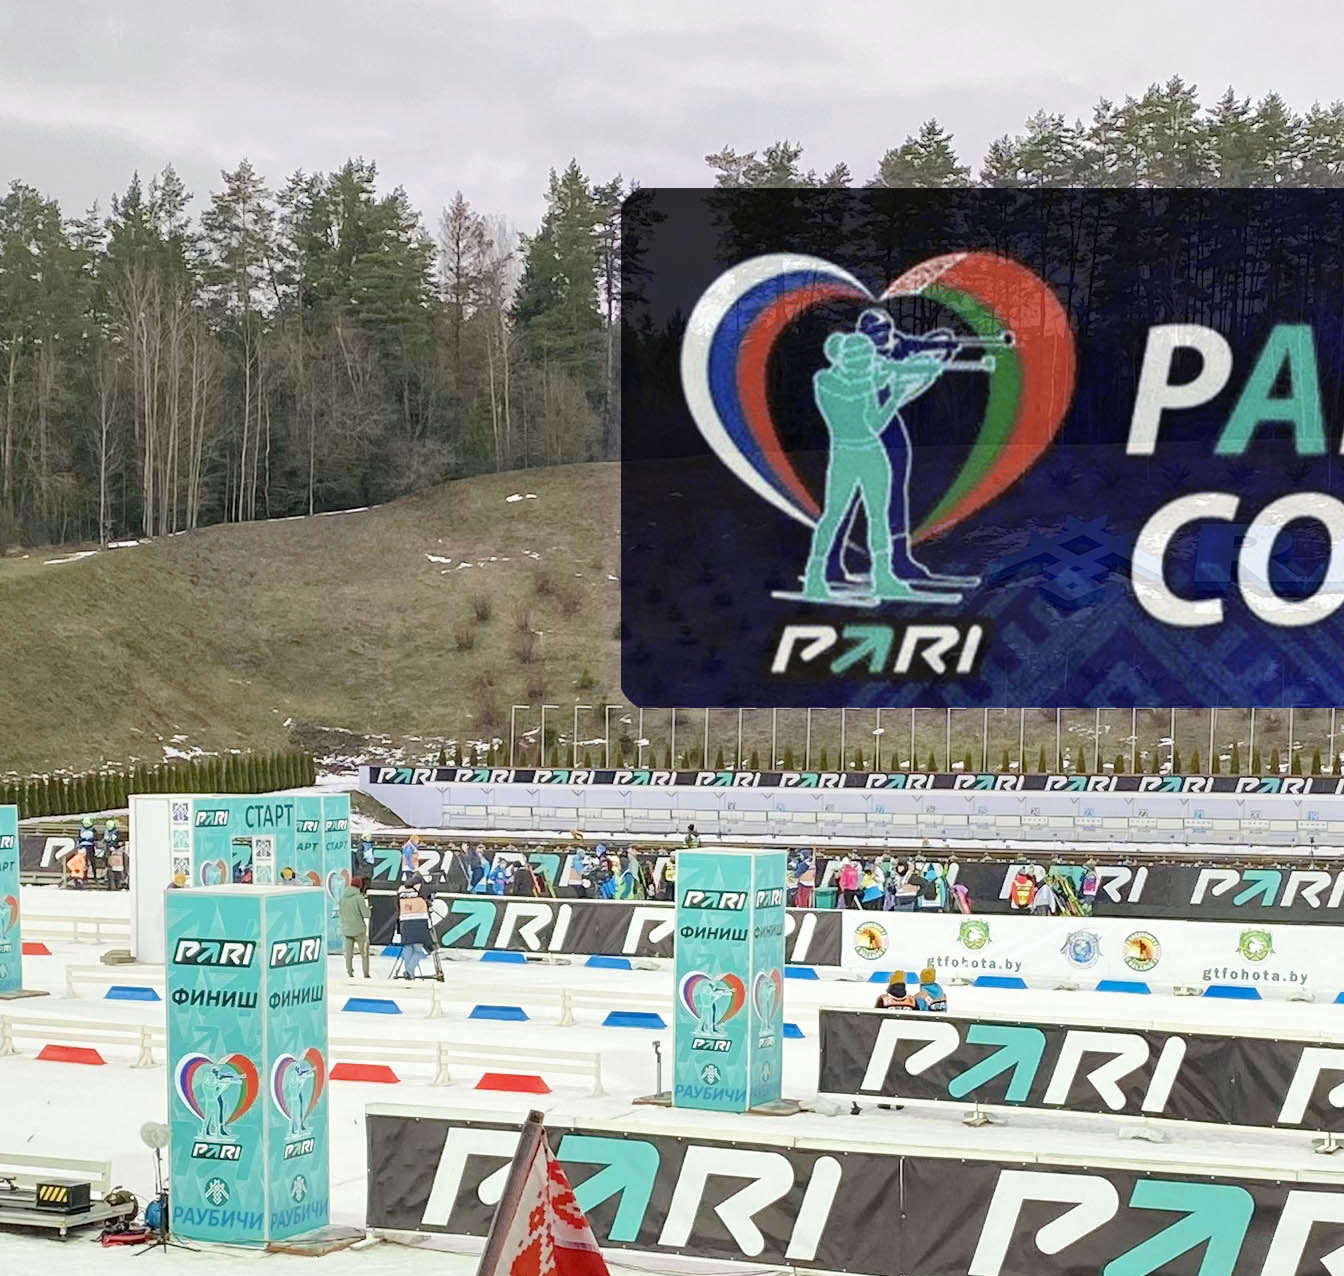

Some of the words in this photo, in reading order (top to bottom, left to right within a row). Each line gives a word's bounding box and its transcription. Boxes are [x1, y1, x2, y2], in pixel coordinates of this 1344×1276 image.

[378, 767, 437, 785] PARI
[455, 768, 515, 784] PARI
[533, 769, 595, 785] PARI
[613, 770, 676, 786] PARI
[696, 771, 761, 787] PARI
[780, 773, 847, 788] PARI
[864, 774, 934, 790] PARI
[954, 775, 1025, 790] PARI
[1044, 776, 1118, 791] PARI
[1138, 776, 1213, 792] PARI
[1234, 777, 1313, 793] PARI
[196, 810, 229, 826] PARI
[245, 804, 293, 828] СТАРТ
[326, 841, 348, 851] СТАРТ
[684, 890, 747, 910] PARI
[756, 888, 783, 908] PARI
[680, 926, 747, 942] ФИНИШ
[175, 940, 254, 966] PARI
[271, 938, 321, 967] PARI
[1202, 967, 1308, 984] gtfohota.by
[172, 988, 258, 1009] ФИНИШ
[269, 985, 324, 1010] ФИНИШ
[692, 1039, 731, 1052] PARI
[860, 1017, 1187, 1112] PARI
[674, 1084, 747, 1102] РАУБИЧИ
[192, 1142, 242, 1161] PARI
[284, 1137, 314, 1160] PARI
[173, 1205, 263, 1231] РАУБИЧИ
[270, 1201, 328, 1230] РАУБИЧИ
